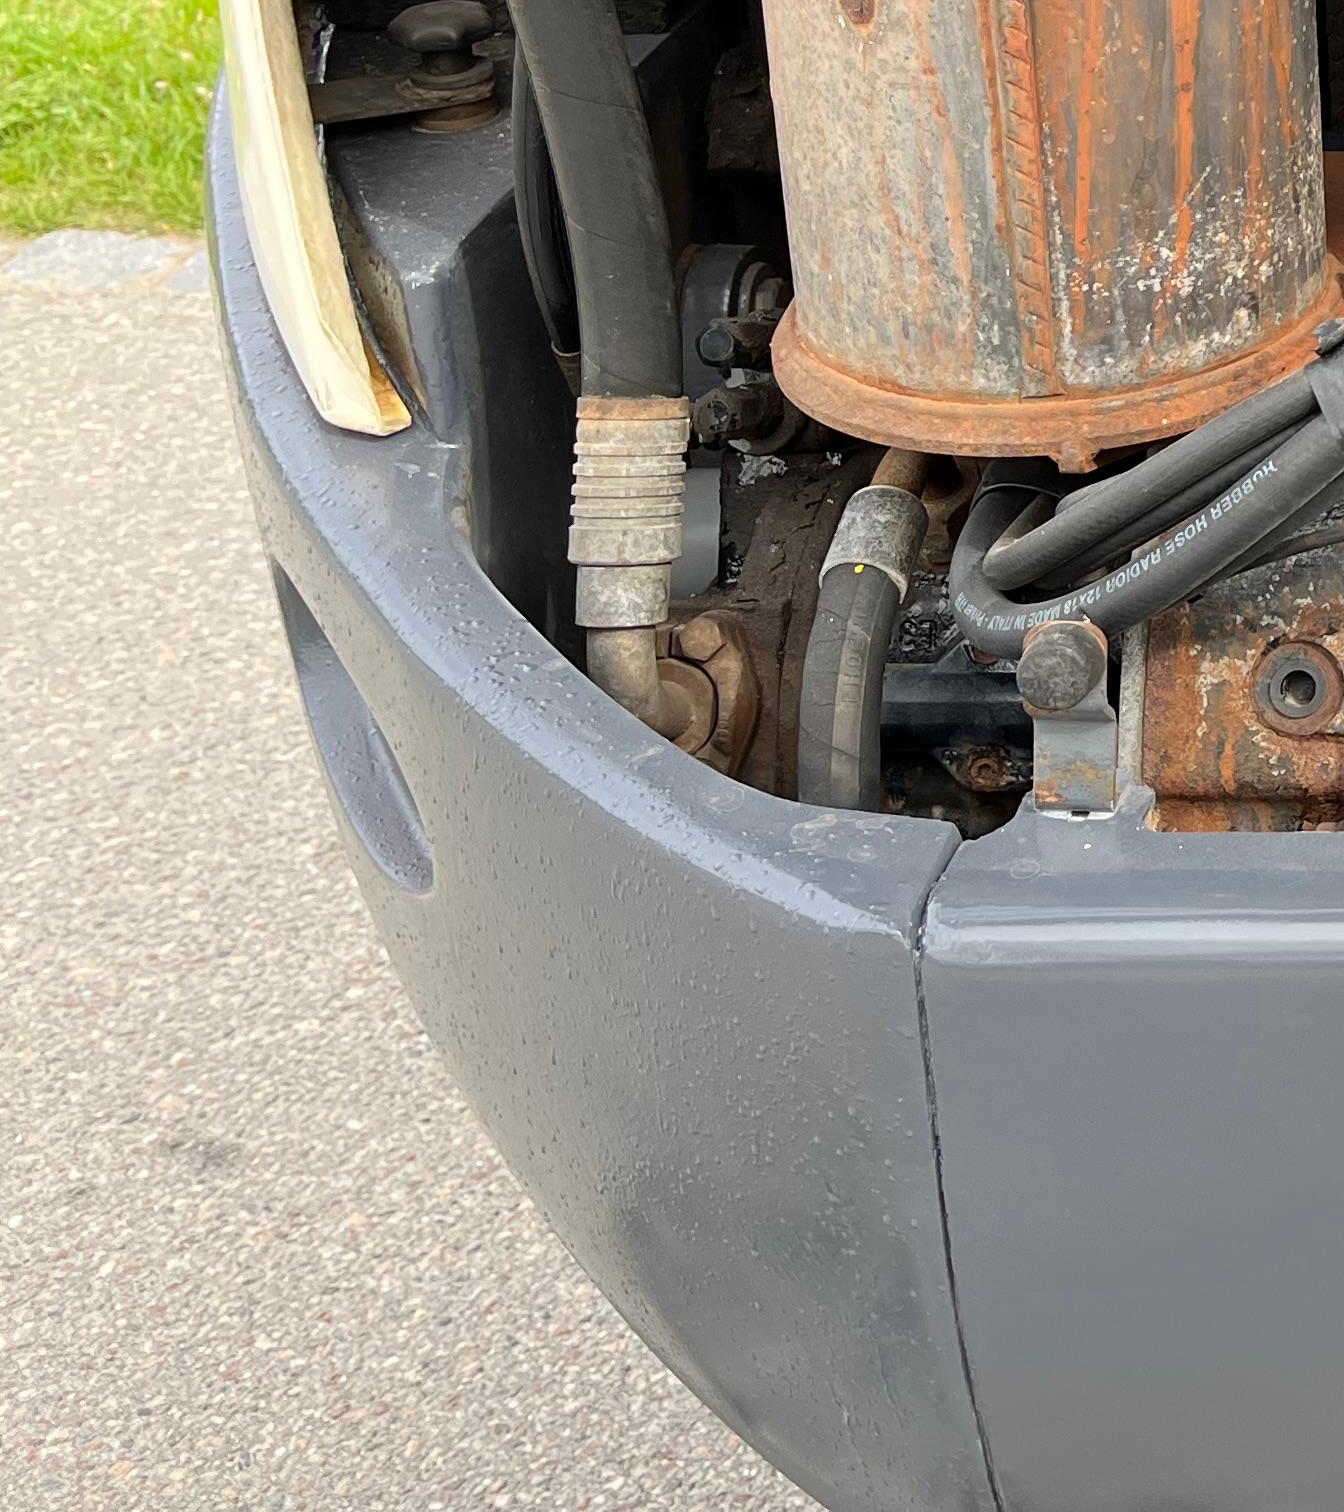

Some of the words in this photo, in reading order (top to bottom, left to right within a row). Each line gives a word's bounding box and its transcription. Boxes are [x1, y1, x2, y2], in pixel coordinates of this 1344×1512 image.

[1164, 518, 1209, 556] HOSE
[1105, 548, 1162, 593] RADIOR
[1026, 603, 1062, 627] MADE
